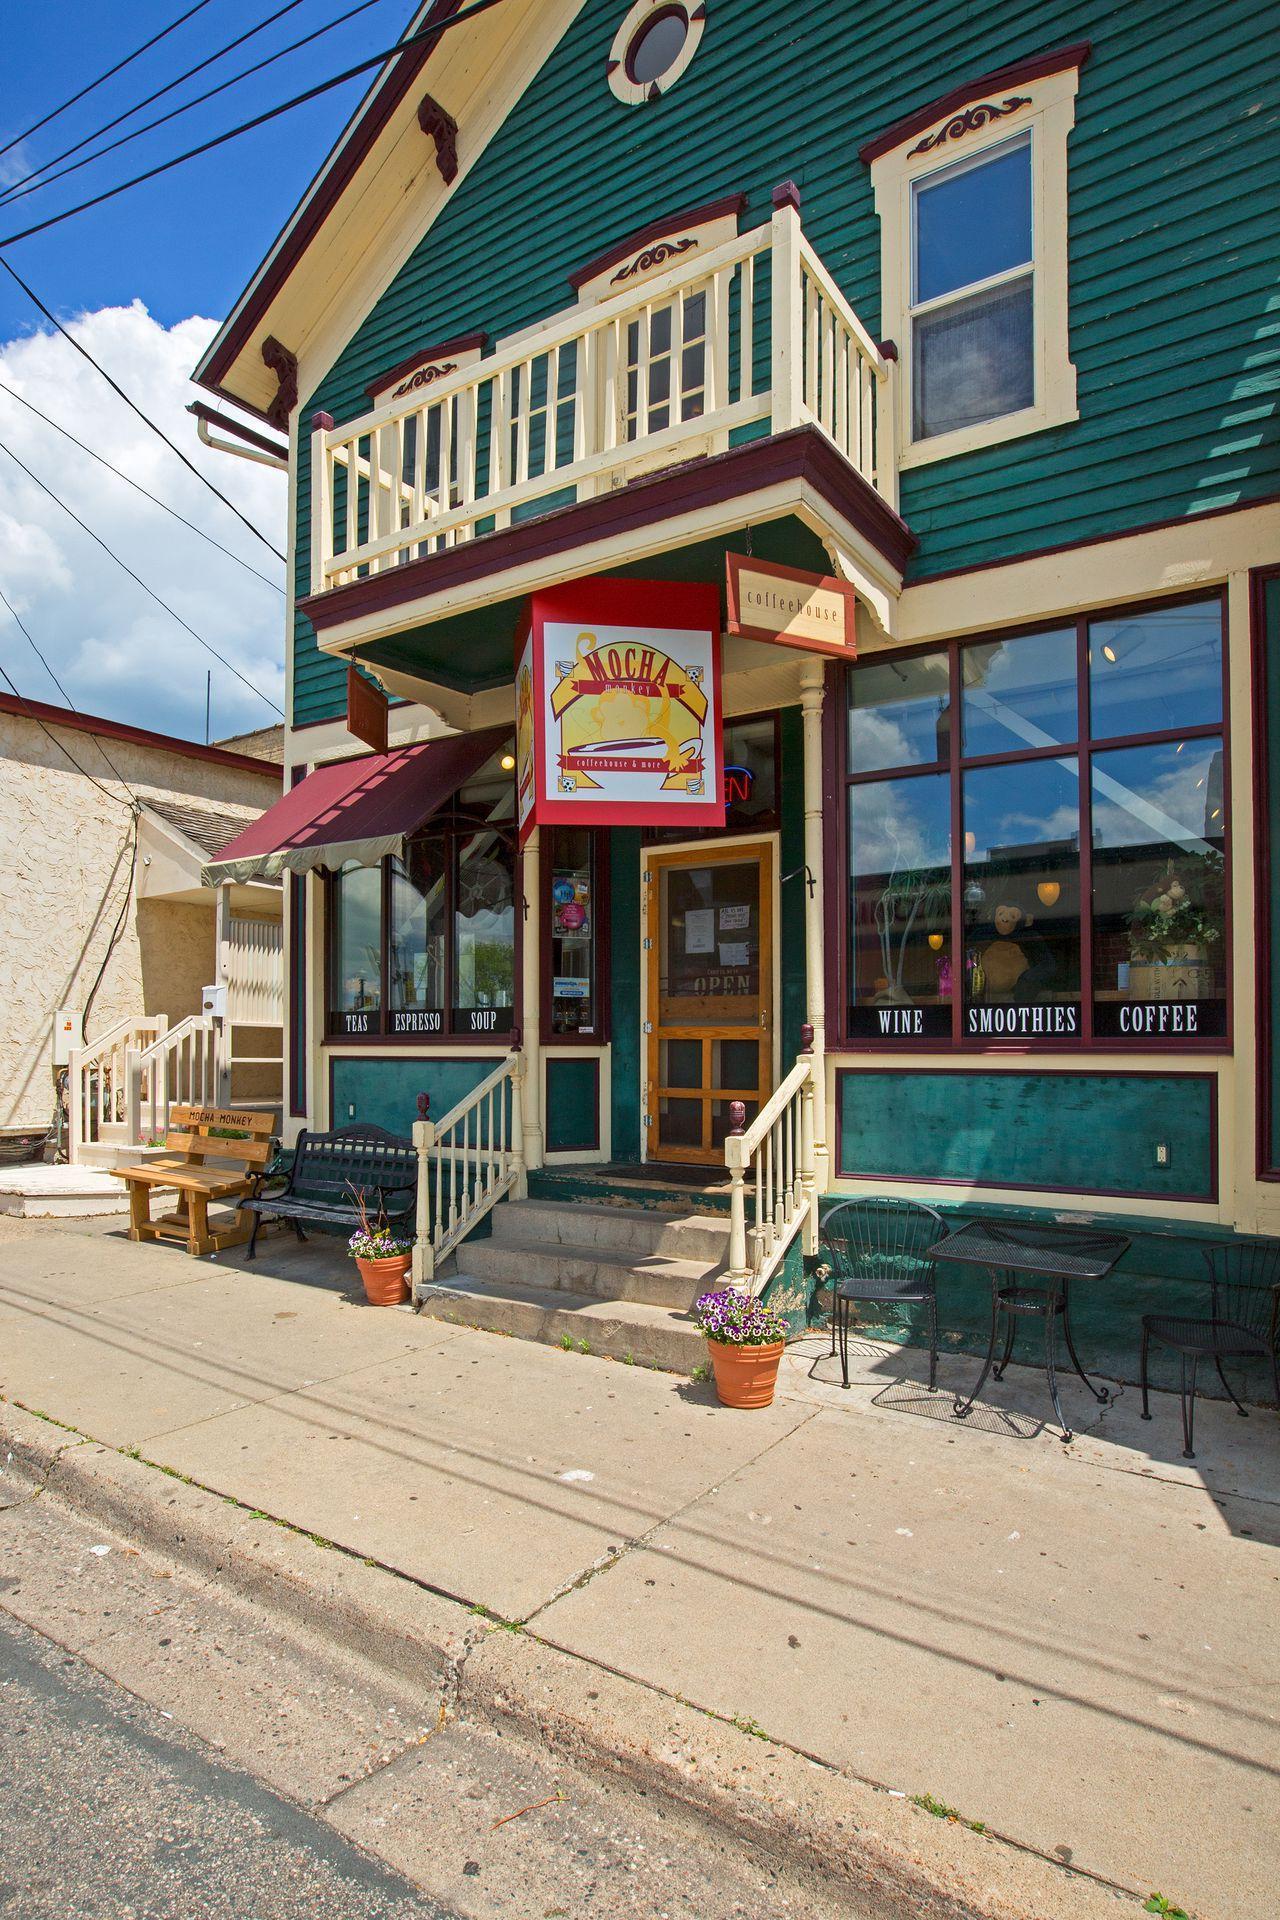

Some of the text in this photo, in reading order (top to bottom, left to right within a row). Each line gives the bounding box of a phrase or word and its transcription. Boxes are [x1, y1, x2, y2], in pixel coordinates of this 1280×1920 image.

[747, 591, 838, 622] coffeehouse
[582, 648, 671, 687] MOCHA
[605, 682, 651, 696] monkey
[576, 759, 628, 769] coffeehouse
[641, 761, 661, 769] more
[695, 975, 750, 996] OPEN
[345, 1015, 368, 1032] TEAS
[395, 1013, 441, 1031] ESPRESSO
[471, 1011, 497, 1030] SOUP
[878, 1009, 924, 1034] WINE
[969, 1006, 1076, 1033] SMOOTHIES
[1120, 1005, 1198, 1032] COFFEE
[189, 1112, 253, 1127] MOCHA MONKEY
